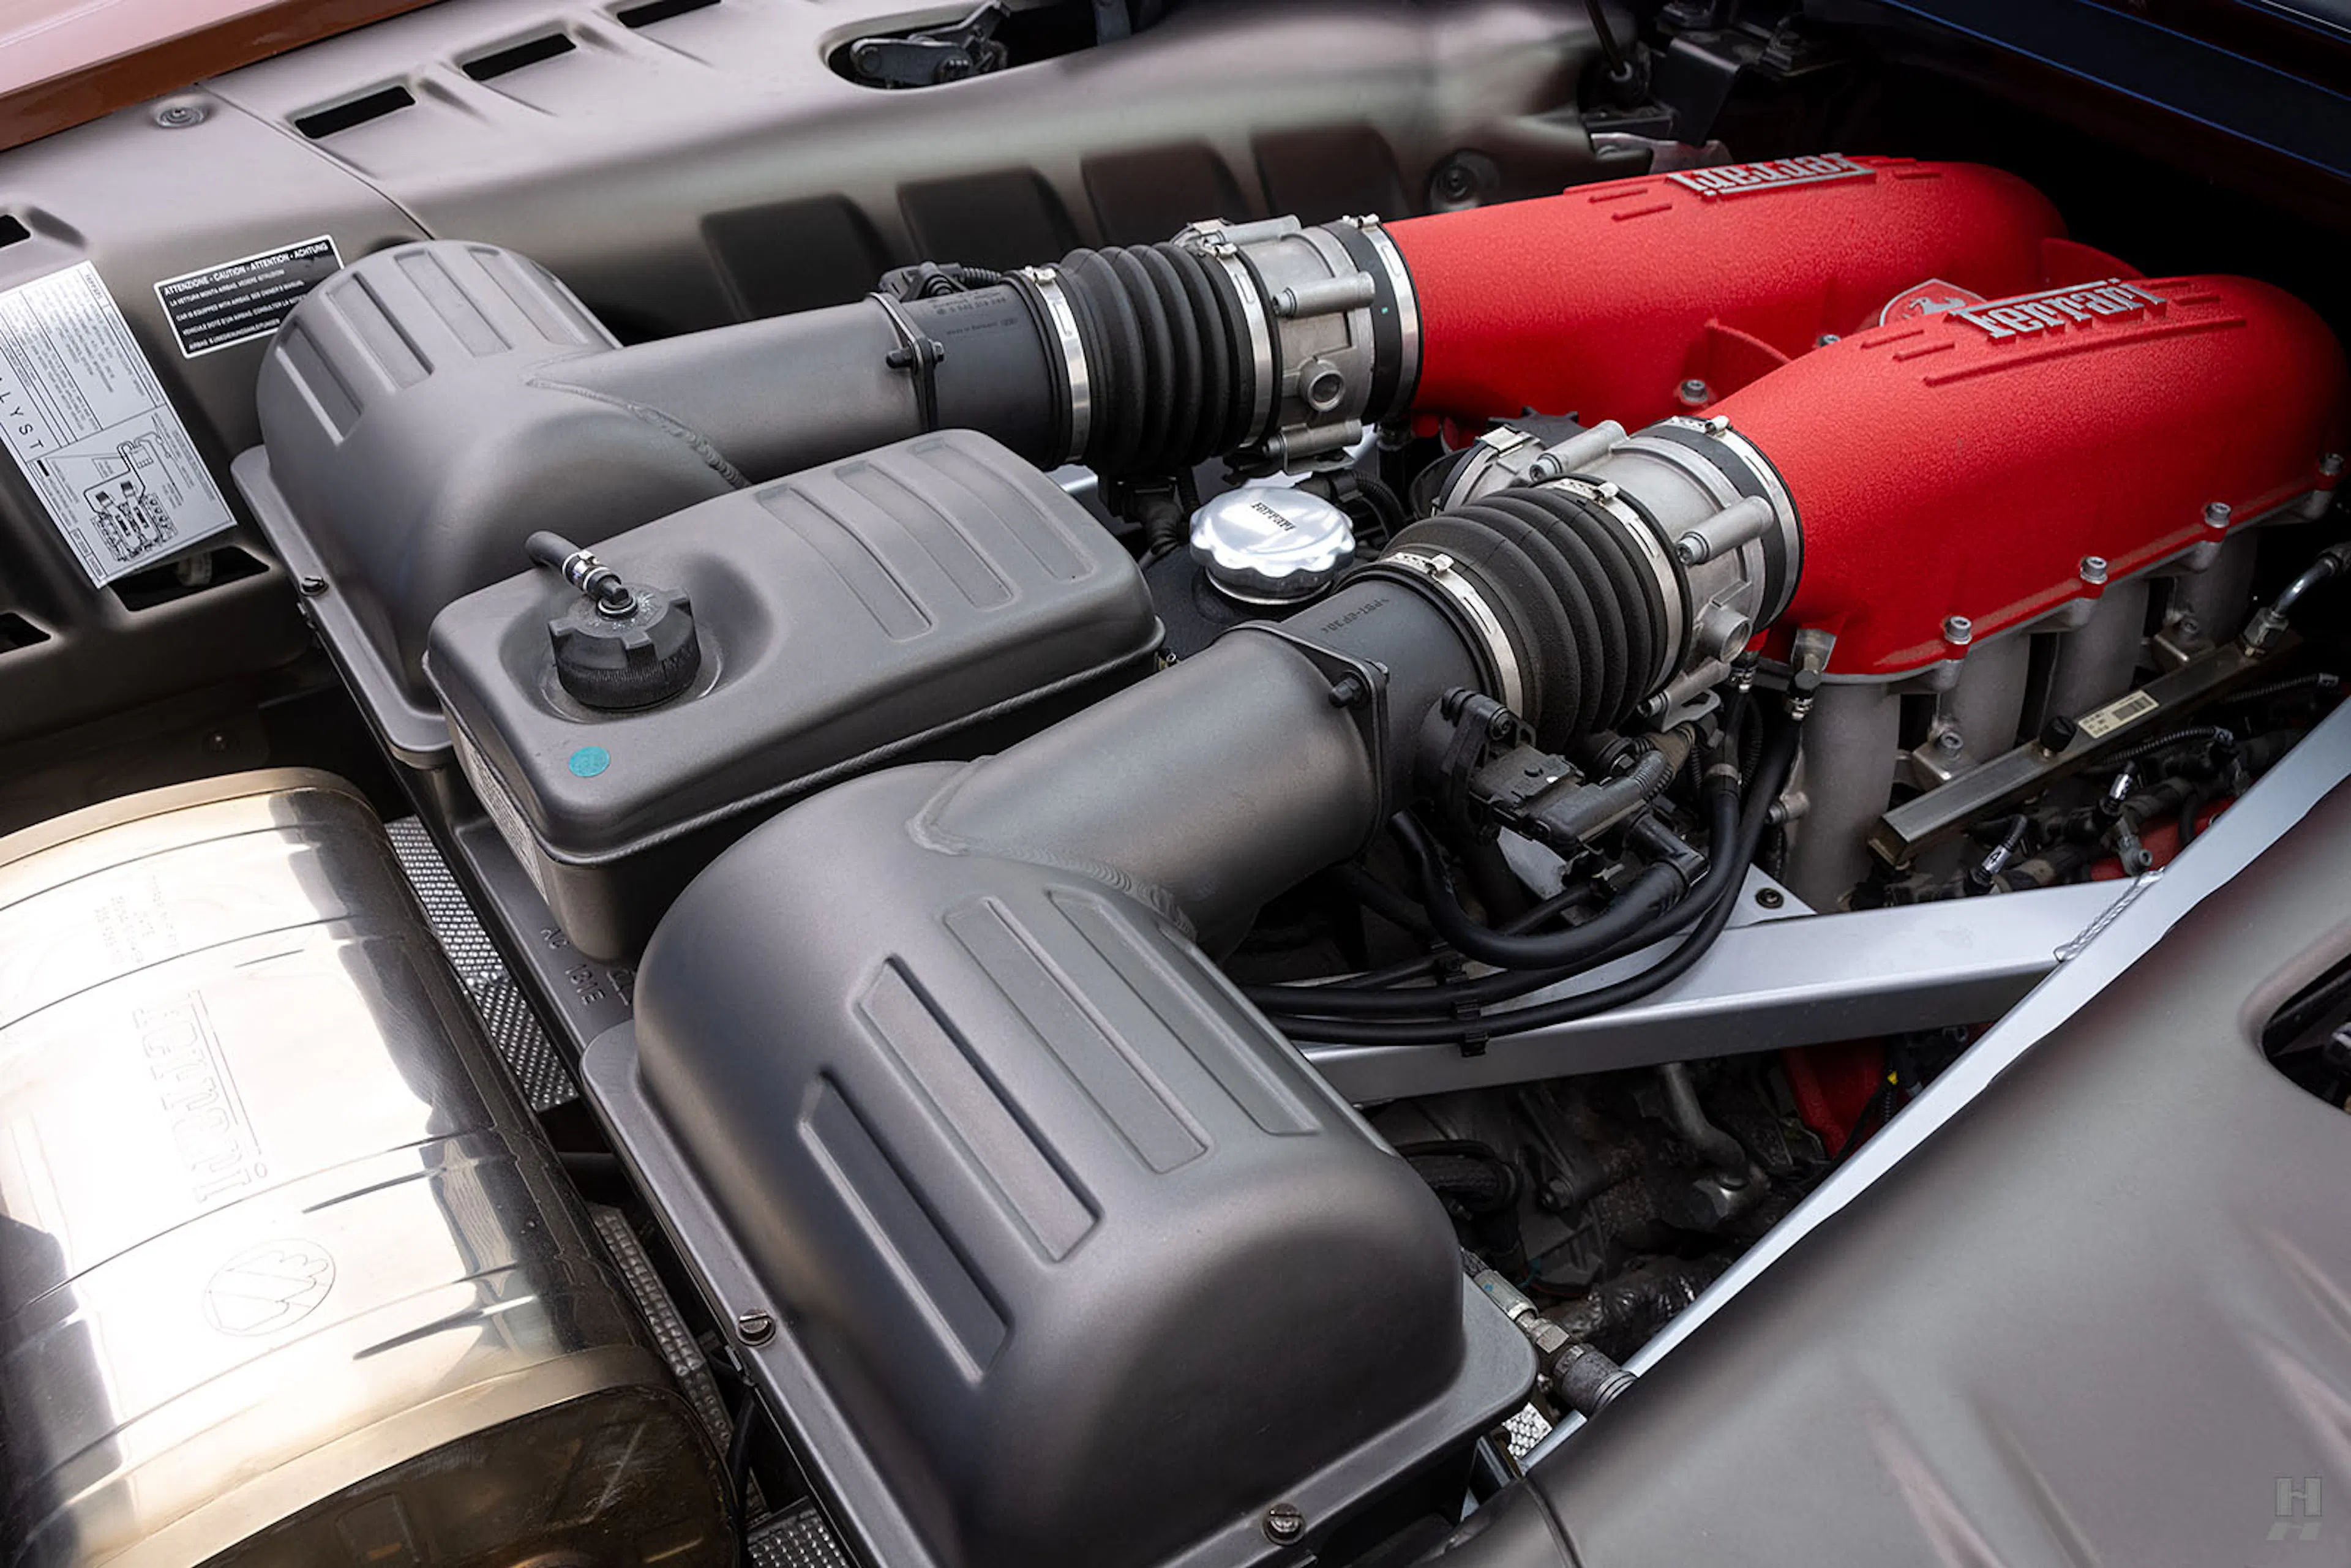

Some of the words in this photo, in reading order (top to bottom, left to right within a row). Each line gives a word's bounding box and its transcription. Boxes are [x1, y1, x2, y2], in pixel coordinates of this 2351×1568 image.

[1667, 152, 1876, 196] Ferrari
[163, 276, 209, 295] ATTENZIONE
[213, 266, 247, 281] CAUTION
[249, 253, 290, 271] ATTENTION
[293, 242, 329, 258] ACHTUNG
[1949, 277, 2167, 343] Ferrari
